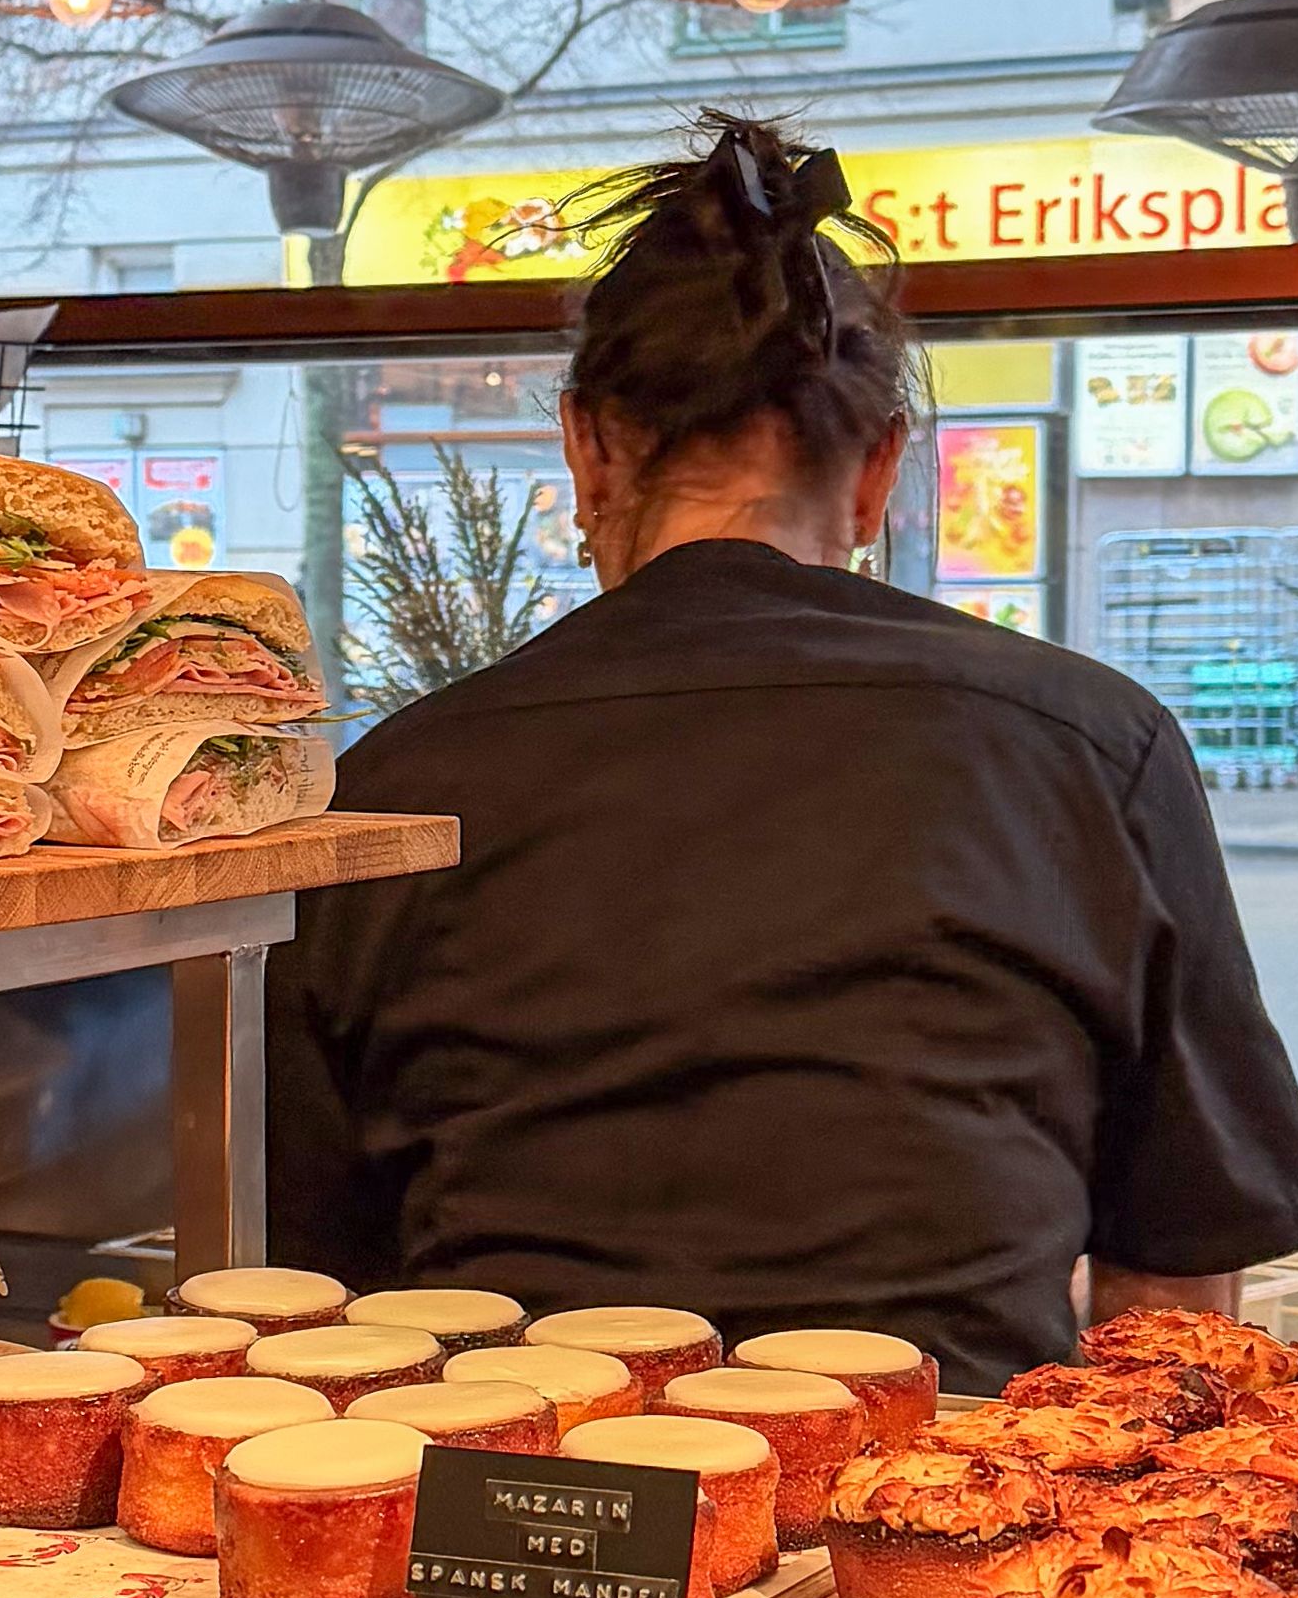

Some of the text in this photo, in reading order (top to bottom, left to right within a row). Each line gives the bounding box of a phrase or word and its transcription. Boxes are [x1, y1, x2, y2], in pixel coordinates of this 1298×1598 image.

[862, 189, 959, 251] S:t
[493, 1491, 629, 1520] MAZARIN
[527, 1535, 587, 1557] MED
[410, 1562, 527, 1592] SPANSK
